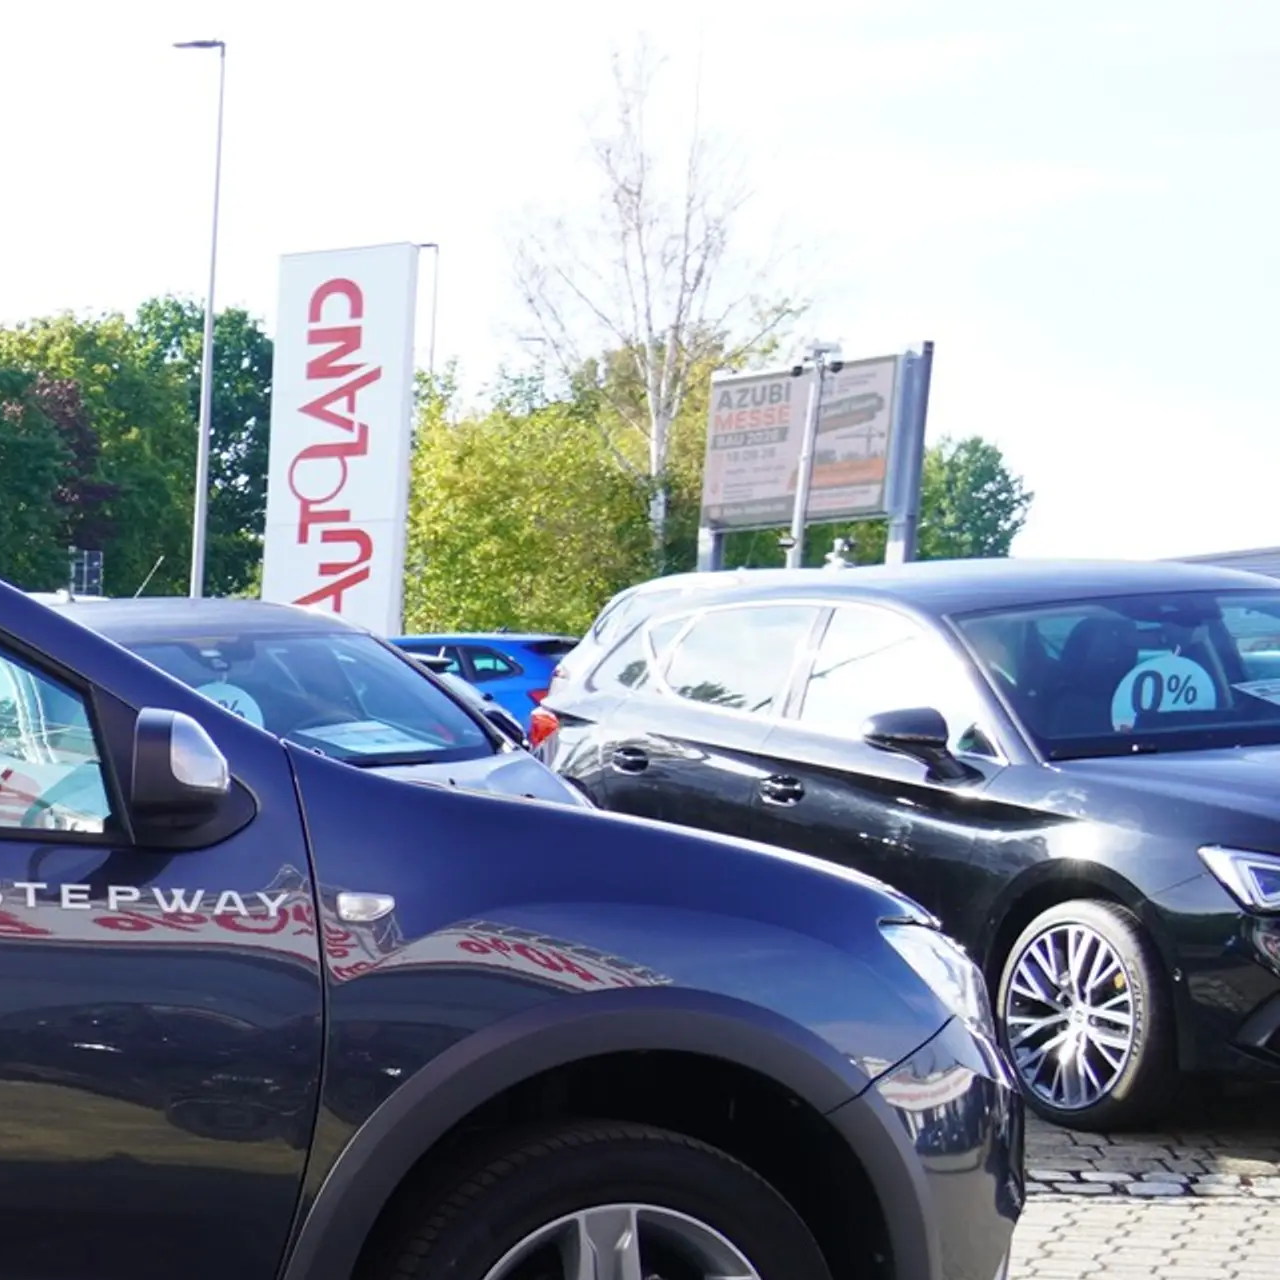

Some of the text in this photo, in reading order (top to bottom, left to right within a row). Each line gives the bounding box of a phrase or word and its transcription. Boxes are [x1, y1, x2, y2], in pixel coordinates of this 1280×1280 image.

[717, 382, 792, 410] AZUBI
[714, 405, 790, 433] MESSE
[1131, 670, 1197, 713] 0%
